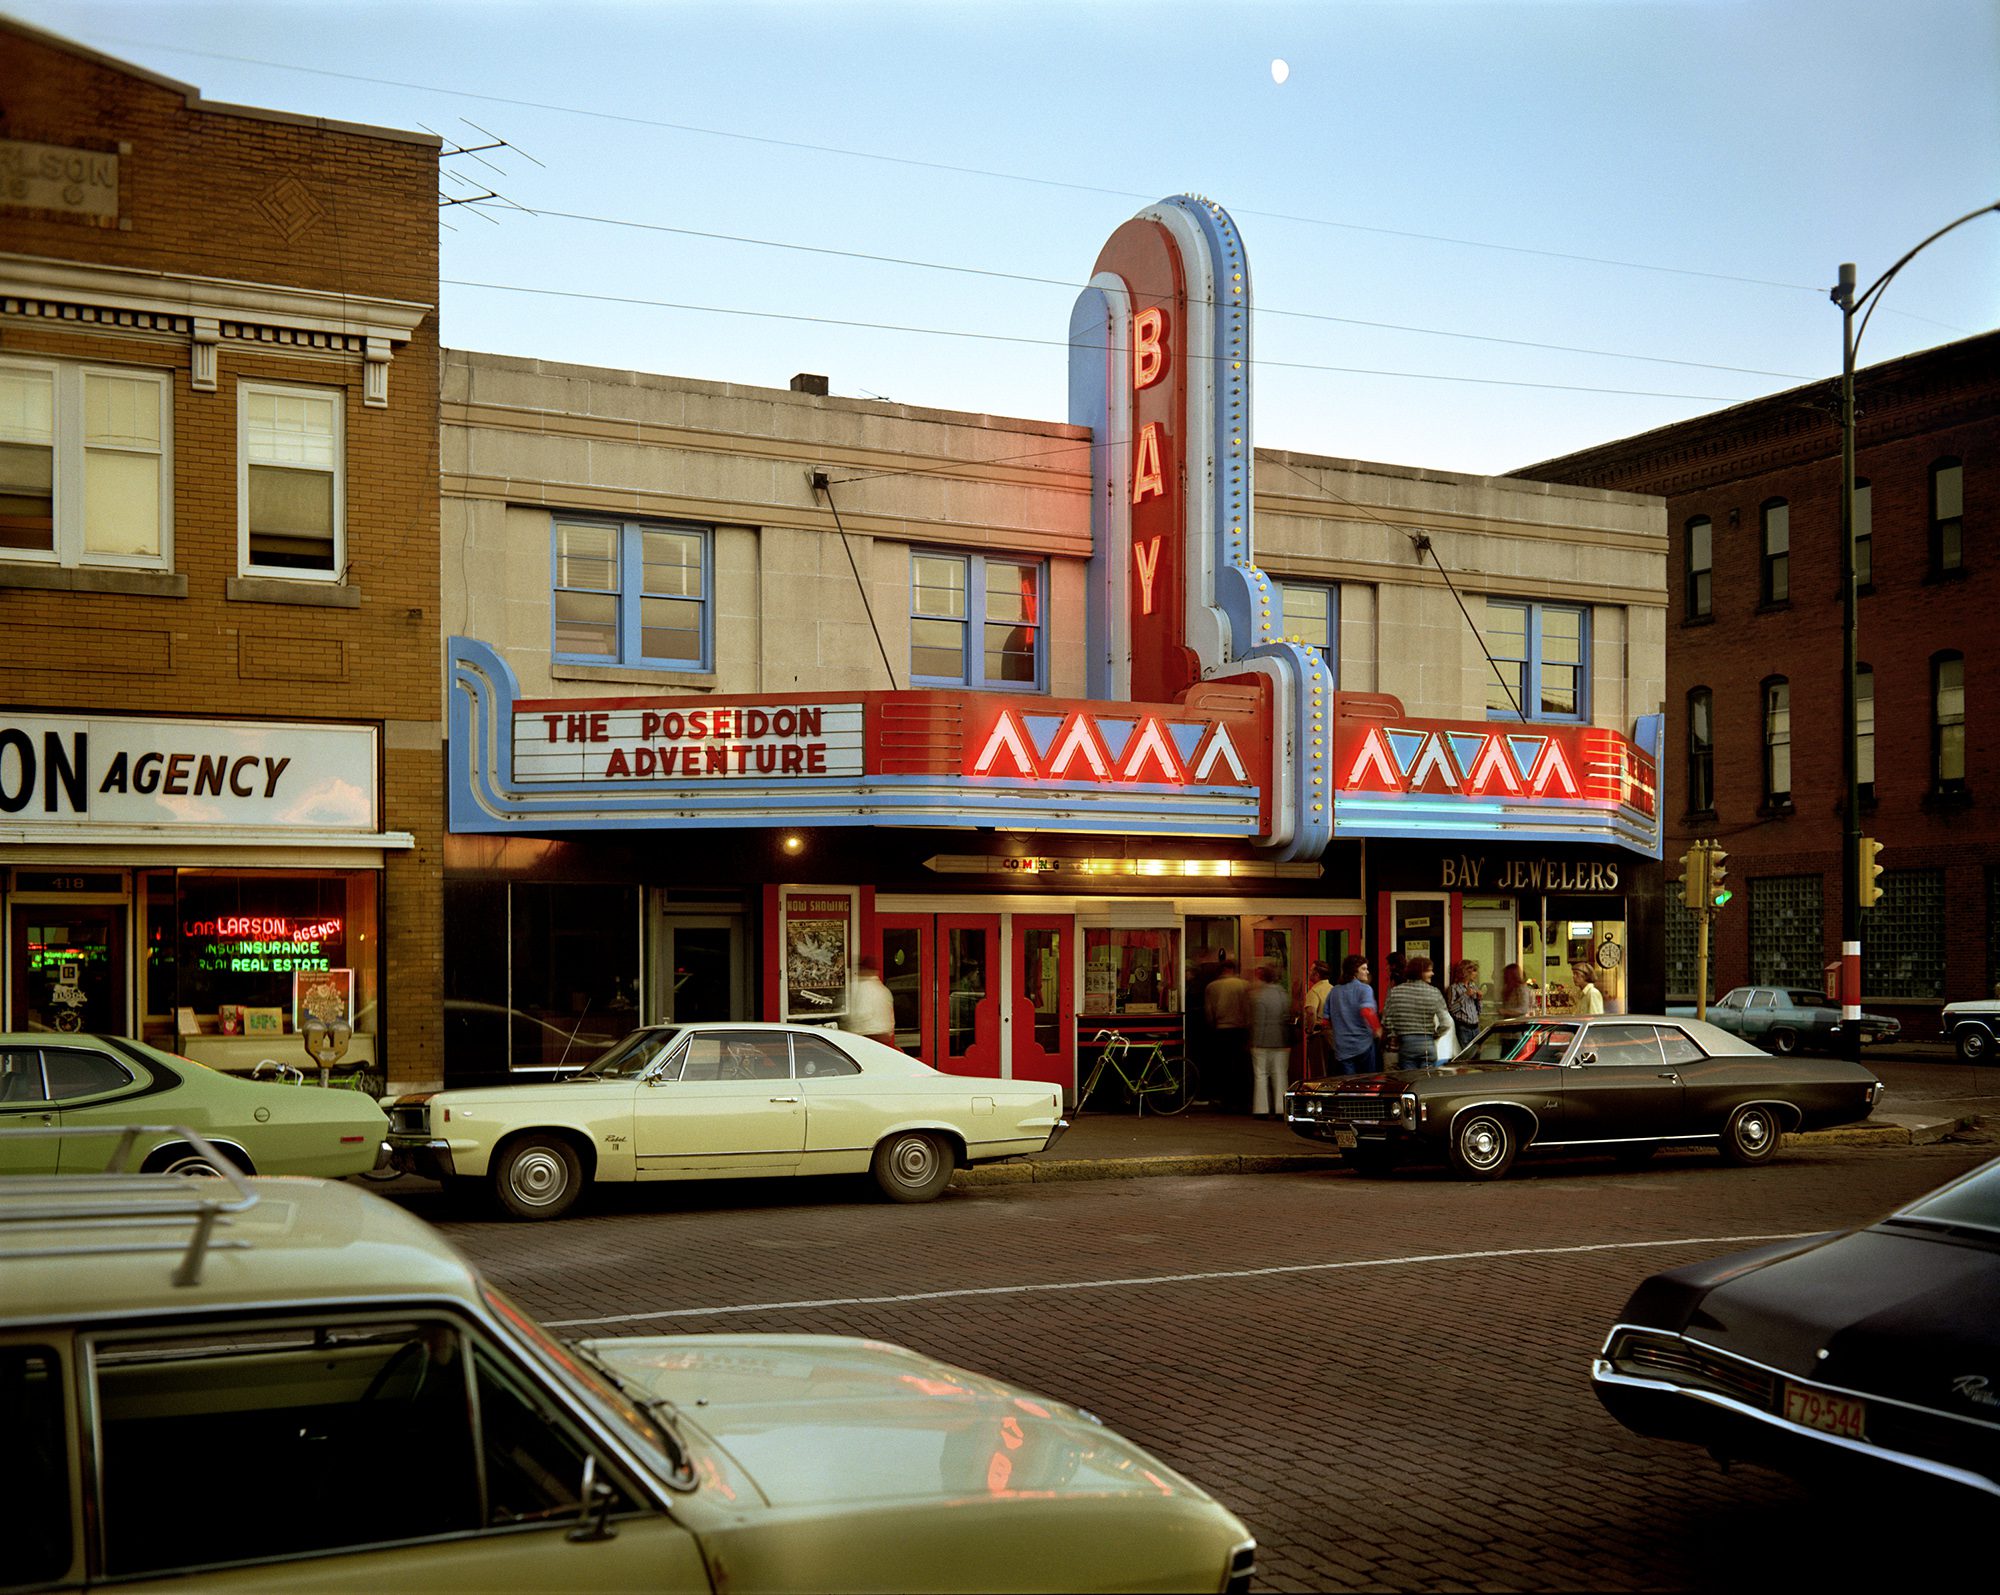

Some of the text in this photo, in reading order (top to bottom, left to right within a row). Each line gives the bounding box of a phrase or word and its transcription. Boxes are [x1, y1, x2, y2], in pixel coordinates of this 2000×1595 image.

[1133, 305, 1169, 616] BAY
[543, 707, 822, 743] THE POSEIDON
[0, 727, 291, 813] ON AGENCY
[606, 743, 827, 778] ADVENTURE
[52, 878, 84, 889] 418
[1441, 854, 1619, 891] BAY JEWELERS
[787, 900, 849, 912] NOW SHOWING
[217, 917, 286, 935] LARSON
[292, 919, 342, 943] AGENCY
[239, 941, 320, 955] INSURANCE
[231, 958, 269, 972] REAL
[273, 958, 329, 972] ESTATE
